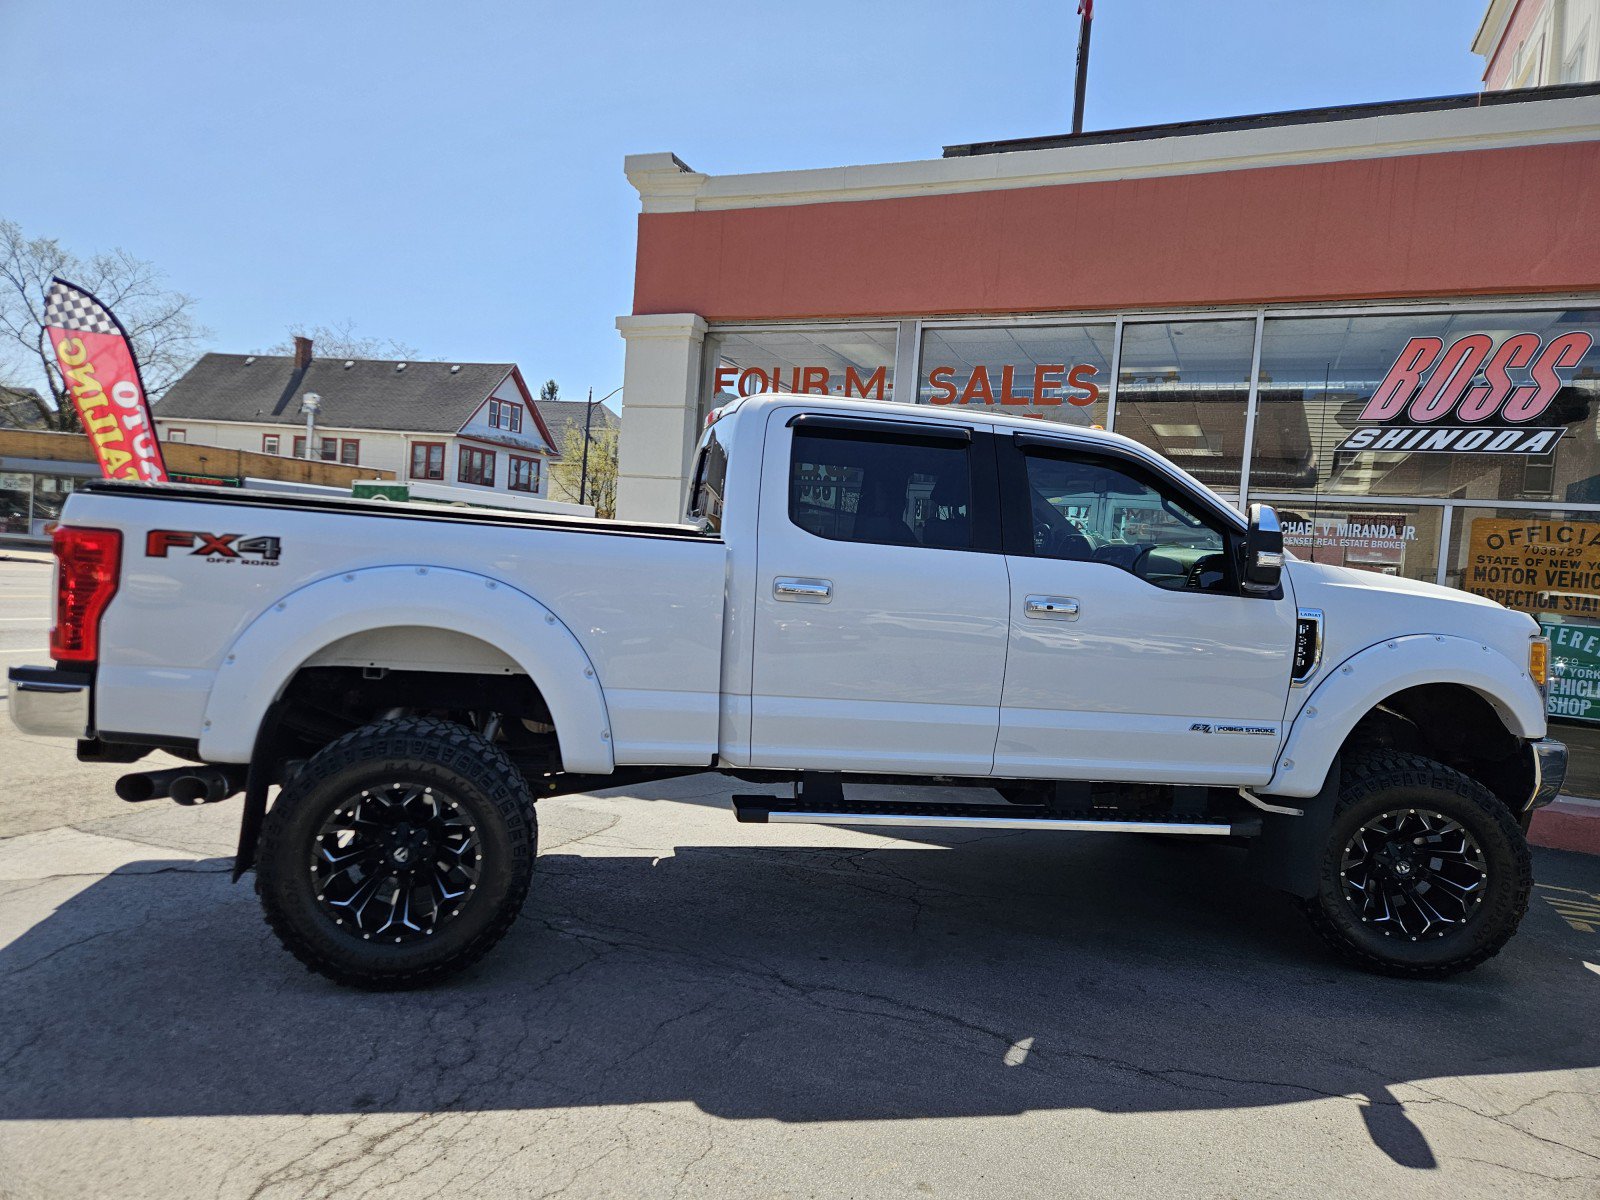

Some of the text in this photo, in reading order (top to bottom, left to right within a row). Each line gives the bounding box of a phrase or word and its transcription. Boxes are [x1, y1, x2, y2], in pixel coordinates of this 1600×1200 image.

[928, 363, 1100, 407] SALES
[1356, 331, 1594, 423] BOSS
[1344, 428, 1557, 453] SHINODA
[1336, 523, 1397, 540] MIRANDA
[145, 529, 281, 560] FX4
[1317, 538, 1338, 548] REAL
[1340, 537, 1369, 548] ESTATE
[1371, 540, 1407, 549] BROKER
[241, 559, 280, 567] ROAD
[1477, 555, 1520, 566] STATE
[1525, 558, 1544, 567] OF
[1549, 559, 1581, 569] NEW
[1474, 566, 1538, 585] MOTOR
[1543, 625, 1600, 658] TERE
[1547, 695, 1592, 716] SHOP
